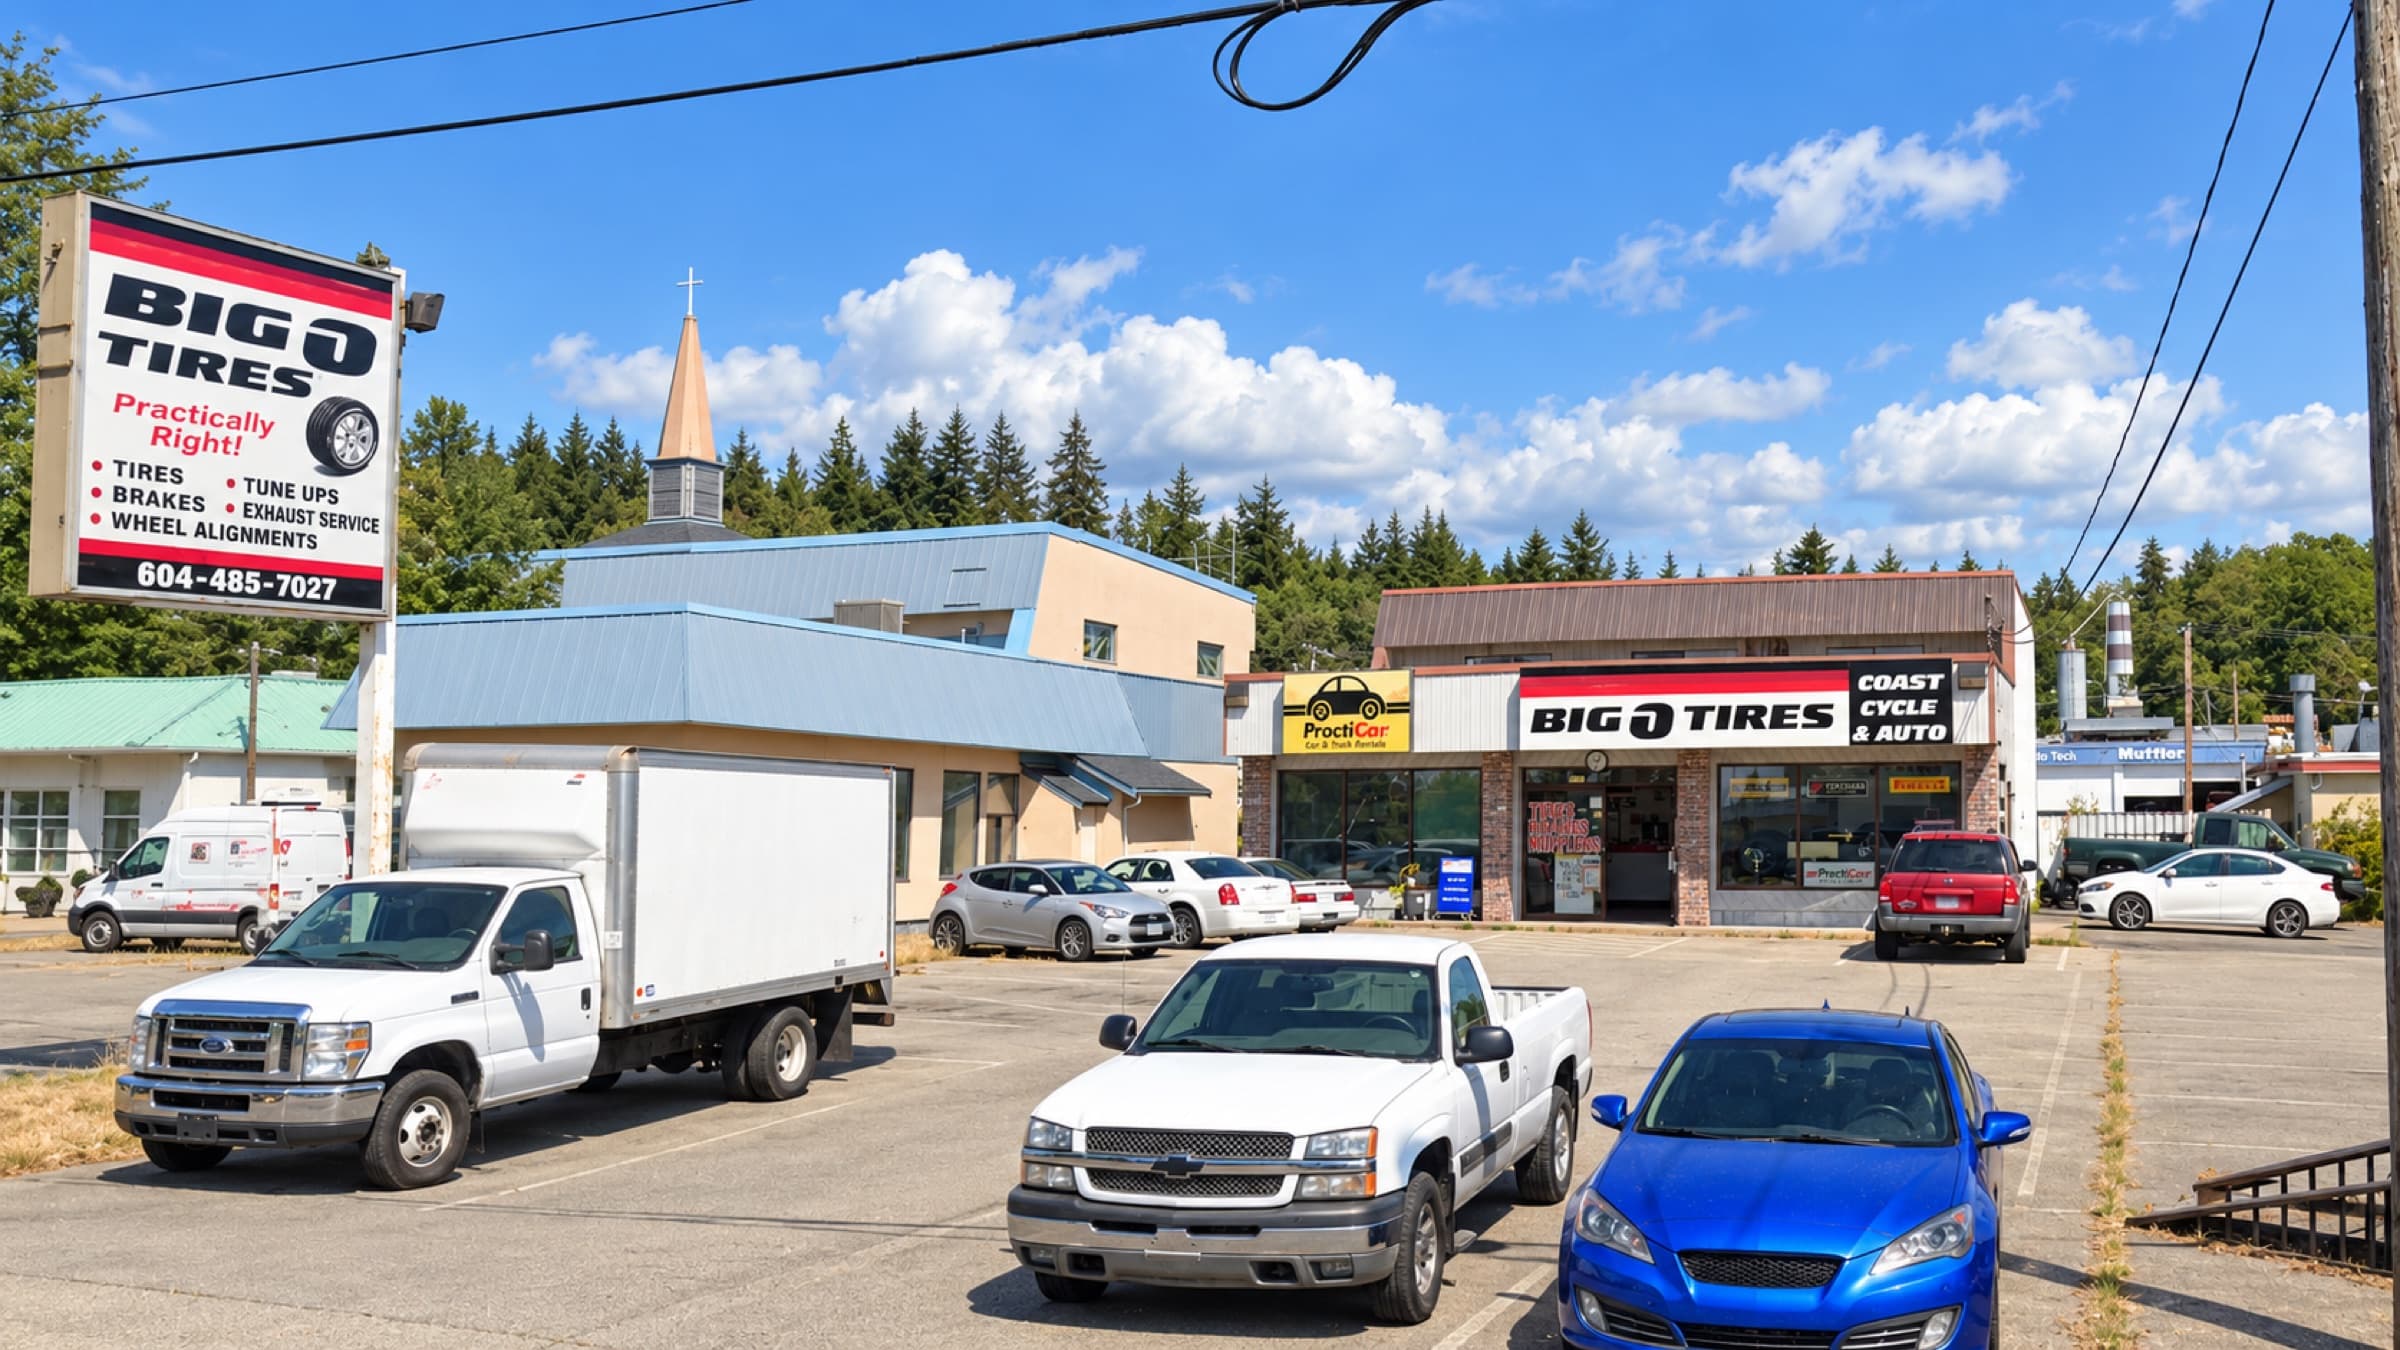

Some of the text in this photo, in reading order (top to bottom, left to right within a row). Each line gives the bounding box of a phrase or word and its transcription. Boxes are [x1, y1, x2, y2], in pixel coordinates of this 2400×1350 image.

[104, 273, 377, 377] BIG O
[98, 331, 313, 398] TIRES
[113, 393, 275, 440] Practically
[150, 426, 242, 457] Right!
[113, 459, 184, 485] TIRES
[113, 485, 206, 513] BRAKES
[244, 477, 339, 504] TUNE UPS
[112, 511, 318, 550] WHEEL ALIGNMENTS
[243, 502, 380, 534] EXHAUST SERVICE
[138, 561, 337, 601] 604-485-7027
[1858, 674, 1945, 691] COAST
[1531, 702, 1834, 740] BIG O TIRES
[1860, 699, 1939, 716] CYCLE
[1852, 724, 1947, 742] & AUTO
[2050, 750, 2077, 761] Tech
